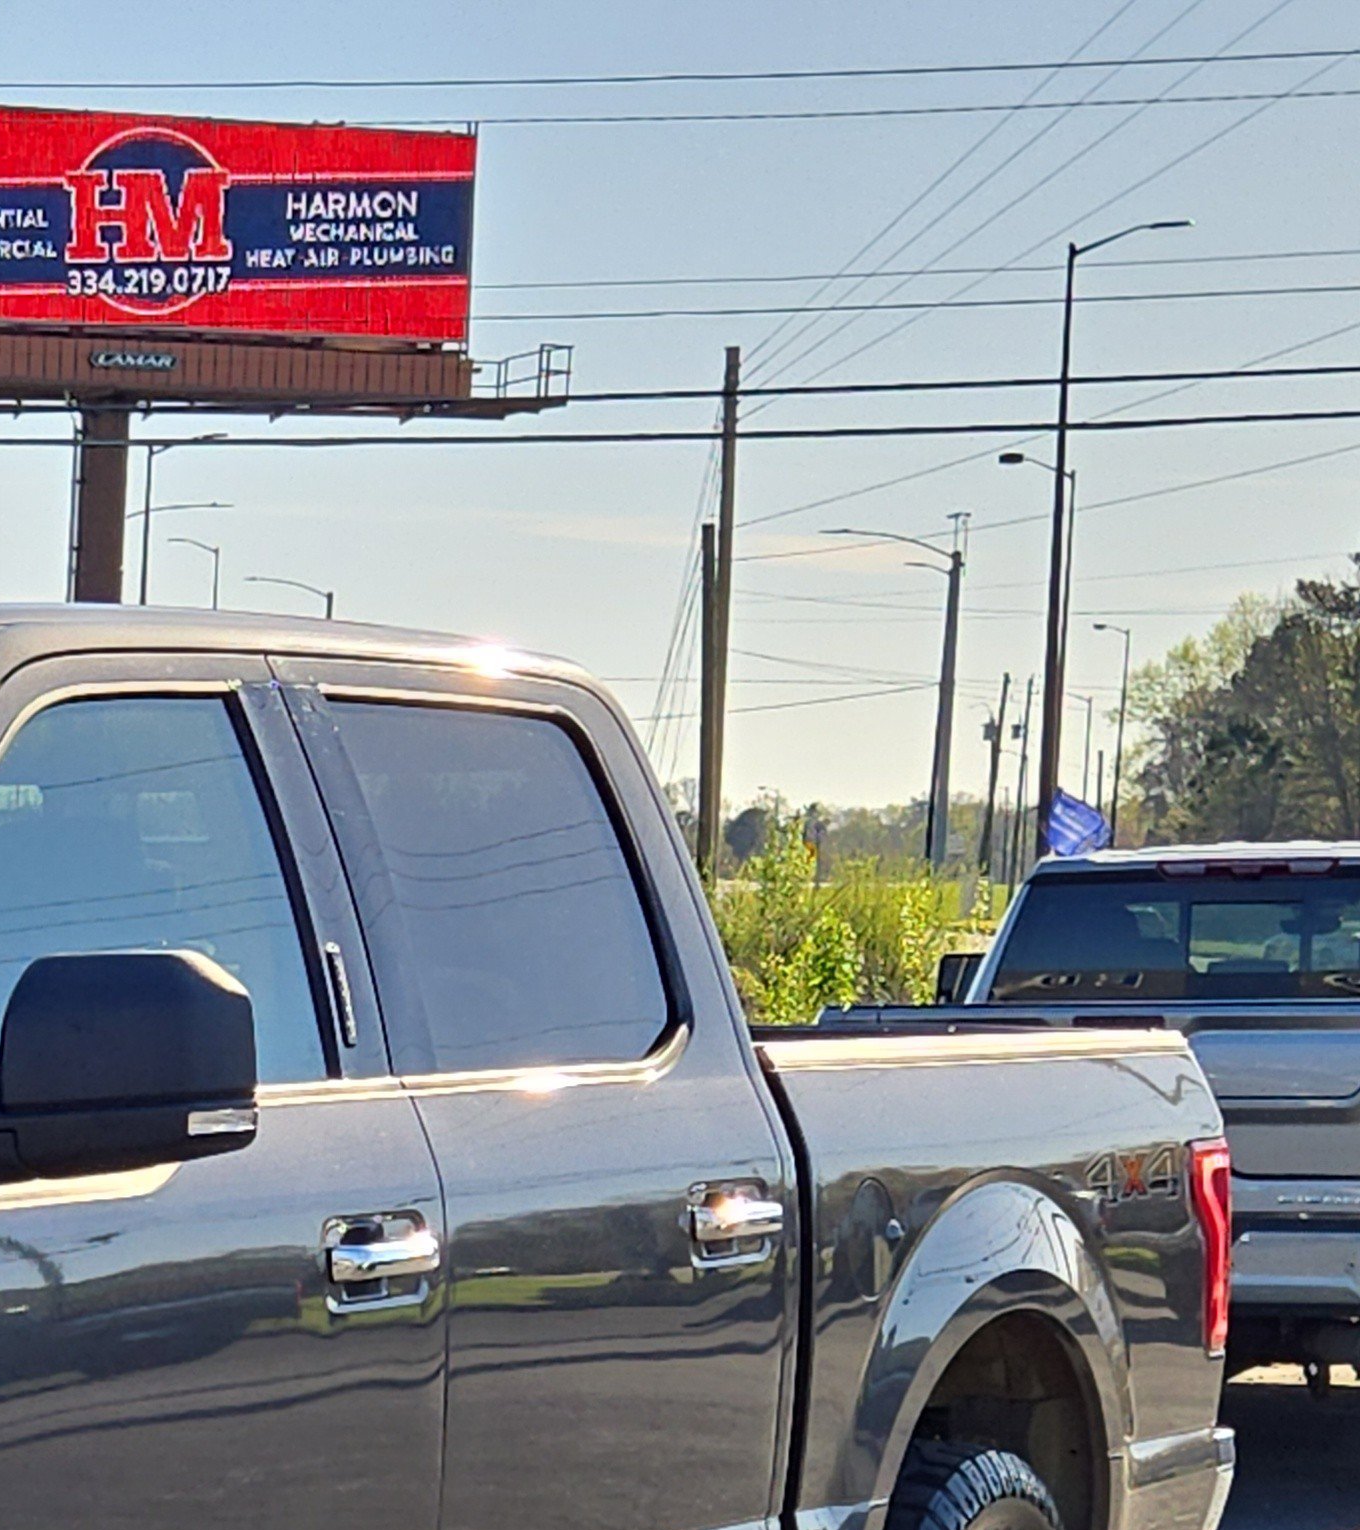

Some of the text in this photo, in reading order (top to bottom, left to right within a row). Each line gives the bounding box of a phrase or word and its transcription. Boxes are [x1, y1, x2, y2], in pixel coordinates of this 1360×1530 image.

[64, 169, 233, 263] HM
[286, 191, 418, 219] HARMON
[290, 223, 419, 242] MECHANICAL
[246, 245, 455, 268] HEAT AIR PLUMBING
[68, 266, 231, 294] 334.219.0717
